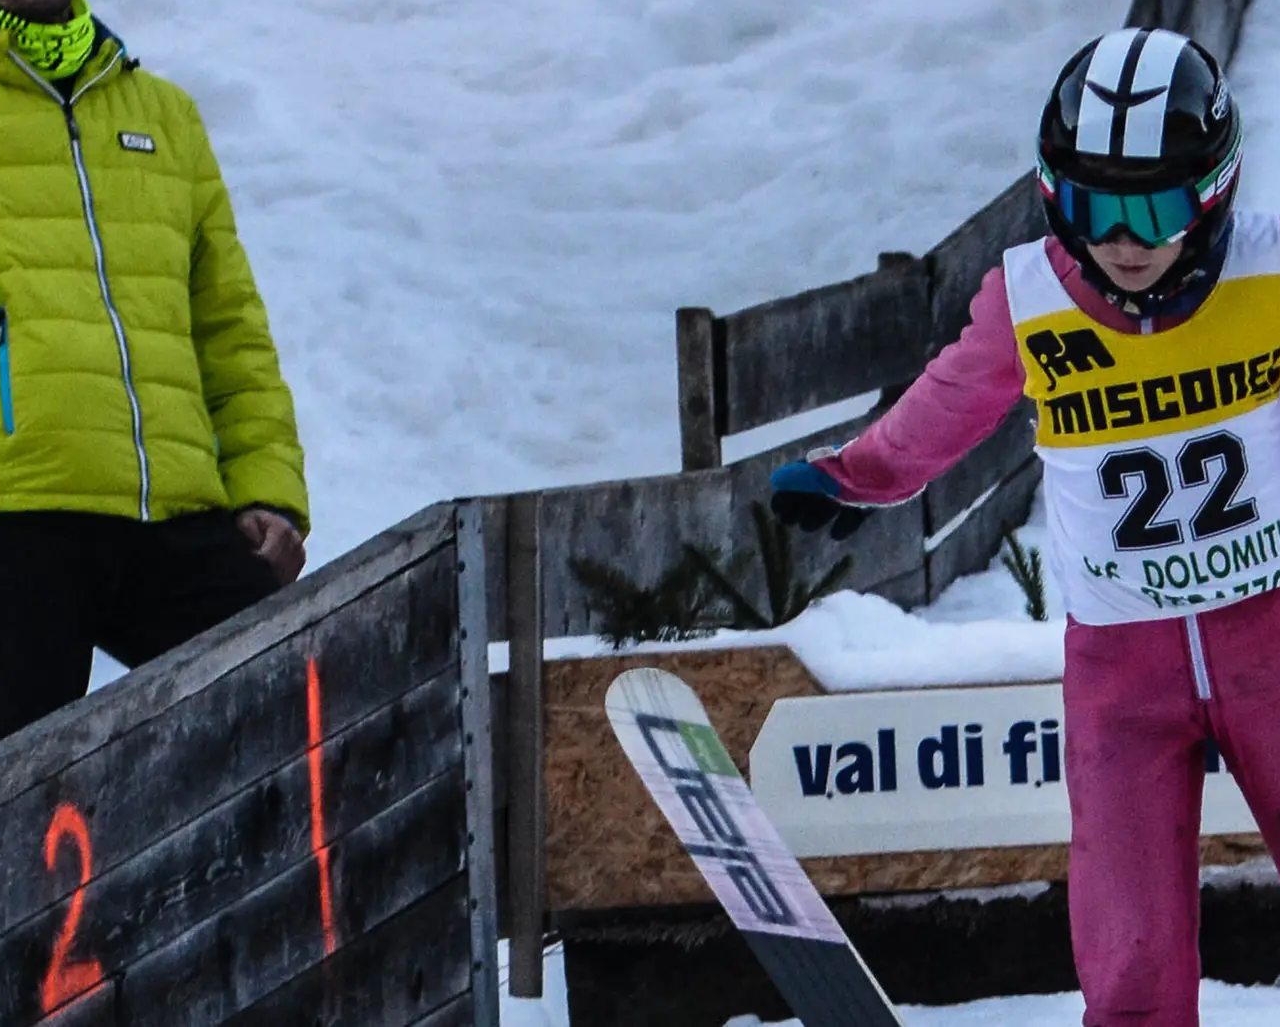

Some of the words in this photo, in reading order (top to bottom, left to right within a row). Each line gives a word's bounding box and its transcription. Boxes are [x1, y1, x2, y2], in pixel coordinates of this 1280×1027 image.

[1097, 429, 1260, 552] 22
[636, 713, 798, 925] elan
[793, 728, 898, 798] val
[918, 723, 984, 789] di
[1003, 719, 1061, 786] fi
[41, 804, 102, 1015] 2
